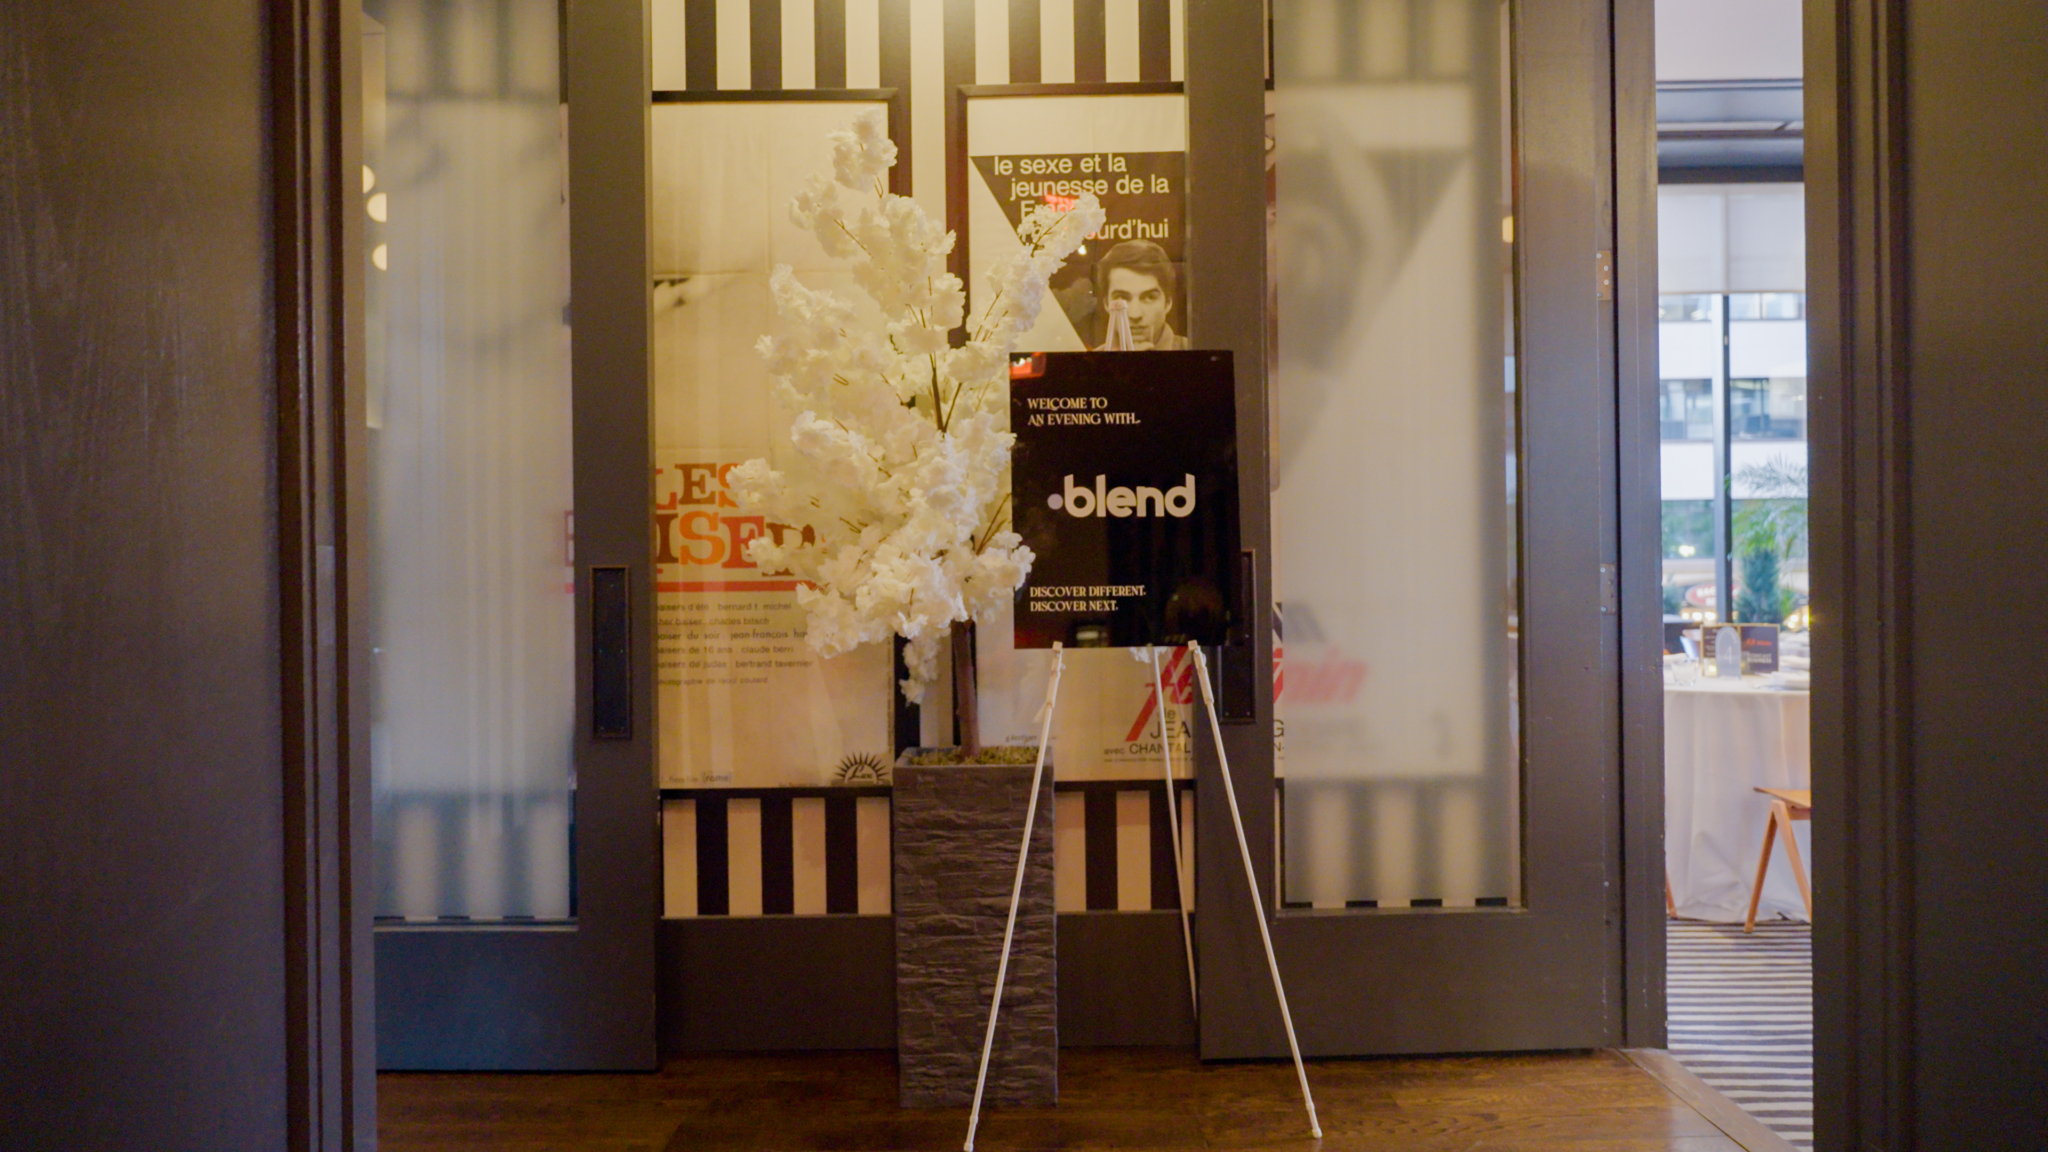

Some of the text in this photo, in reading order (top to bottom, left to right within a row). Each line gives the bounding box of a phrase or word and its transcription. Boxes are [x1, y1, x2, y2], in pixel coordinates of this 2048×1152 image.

[994, 153, 1127, 175] le sexe et la
[1010, 173, 1170, 201] jeunesse de la
[1027, 397, 1108, 411] WELCOME TO
[1028, 413, 1044, 427] AN
[1047, 413, 1101, 425] EVENING
[1029, 585, 1147, 598] DISCOVER DIFFERENT.
[717, 602, 752, 611] bernard
[763, 602, 792, 611] michel
[1030, 600, 1119, 612] DISCOVER NEXT.
[709, 618, 742, 626] charles
[687, 630, 699, 640] du
[689, 646, 700, 654] de
[741, 645, 770, 653] claude
[773, 645, 794, 653] berri
[735, 659, 772, 668] bertrand
[774, 660, 813, 668] tavernier
